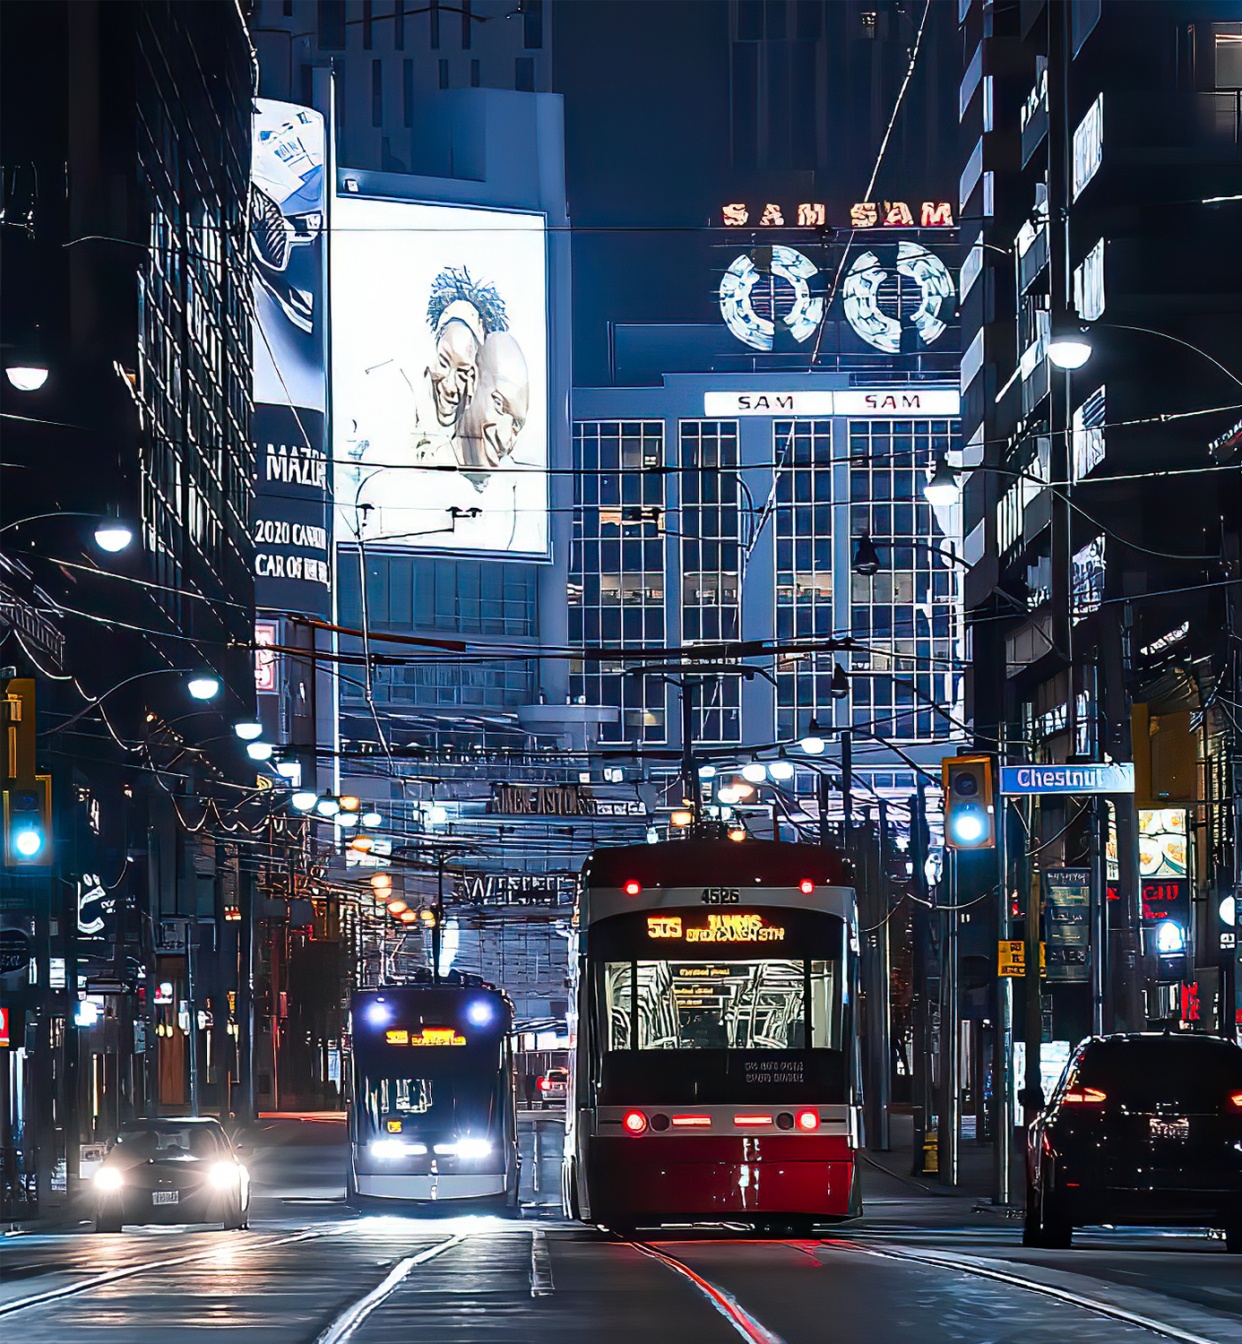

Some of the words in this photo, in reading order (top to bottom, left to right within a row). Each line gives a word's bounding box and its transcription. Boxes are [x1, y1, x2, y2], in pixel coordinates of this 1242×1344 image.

[722, 203, 826, 226] SAM
[850, 202, 954, 226] SAM
[738, 395, 794, 410] SAM
[865, 394, 921, 409] SAM
[254, 519, 290, 544] 2020
[254, 553, 285, 578] CAR
[1017, 768, 1104, 788] Chestnut
